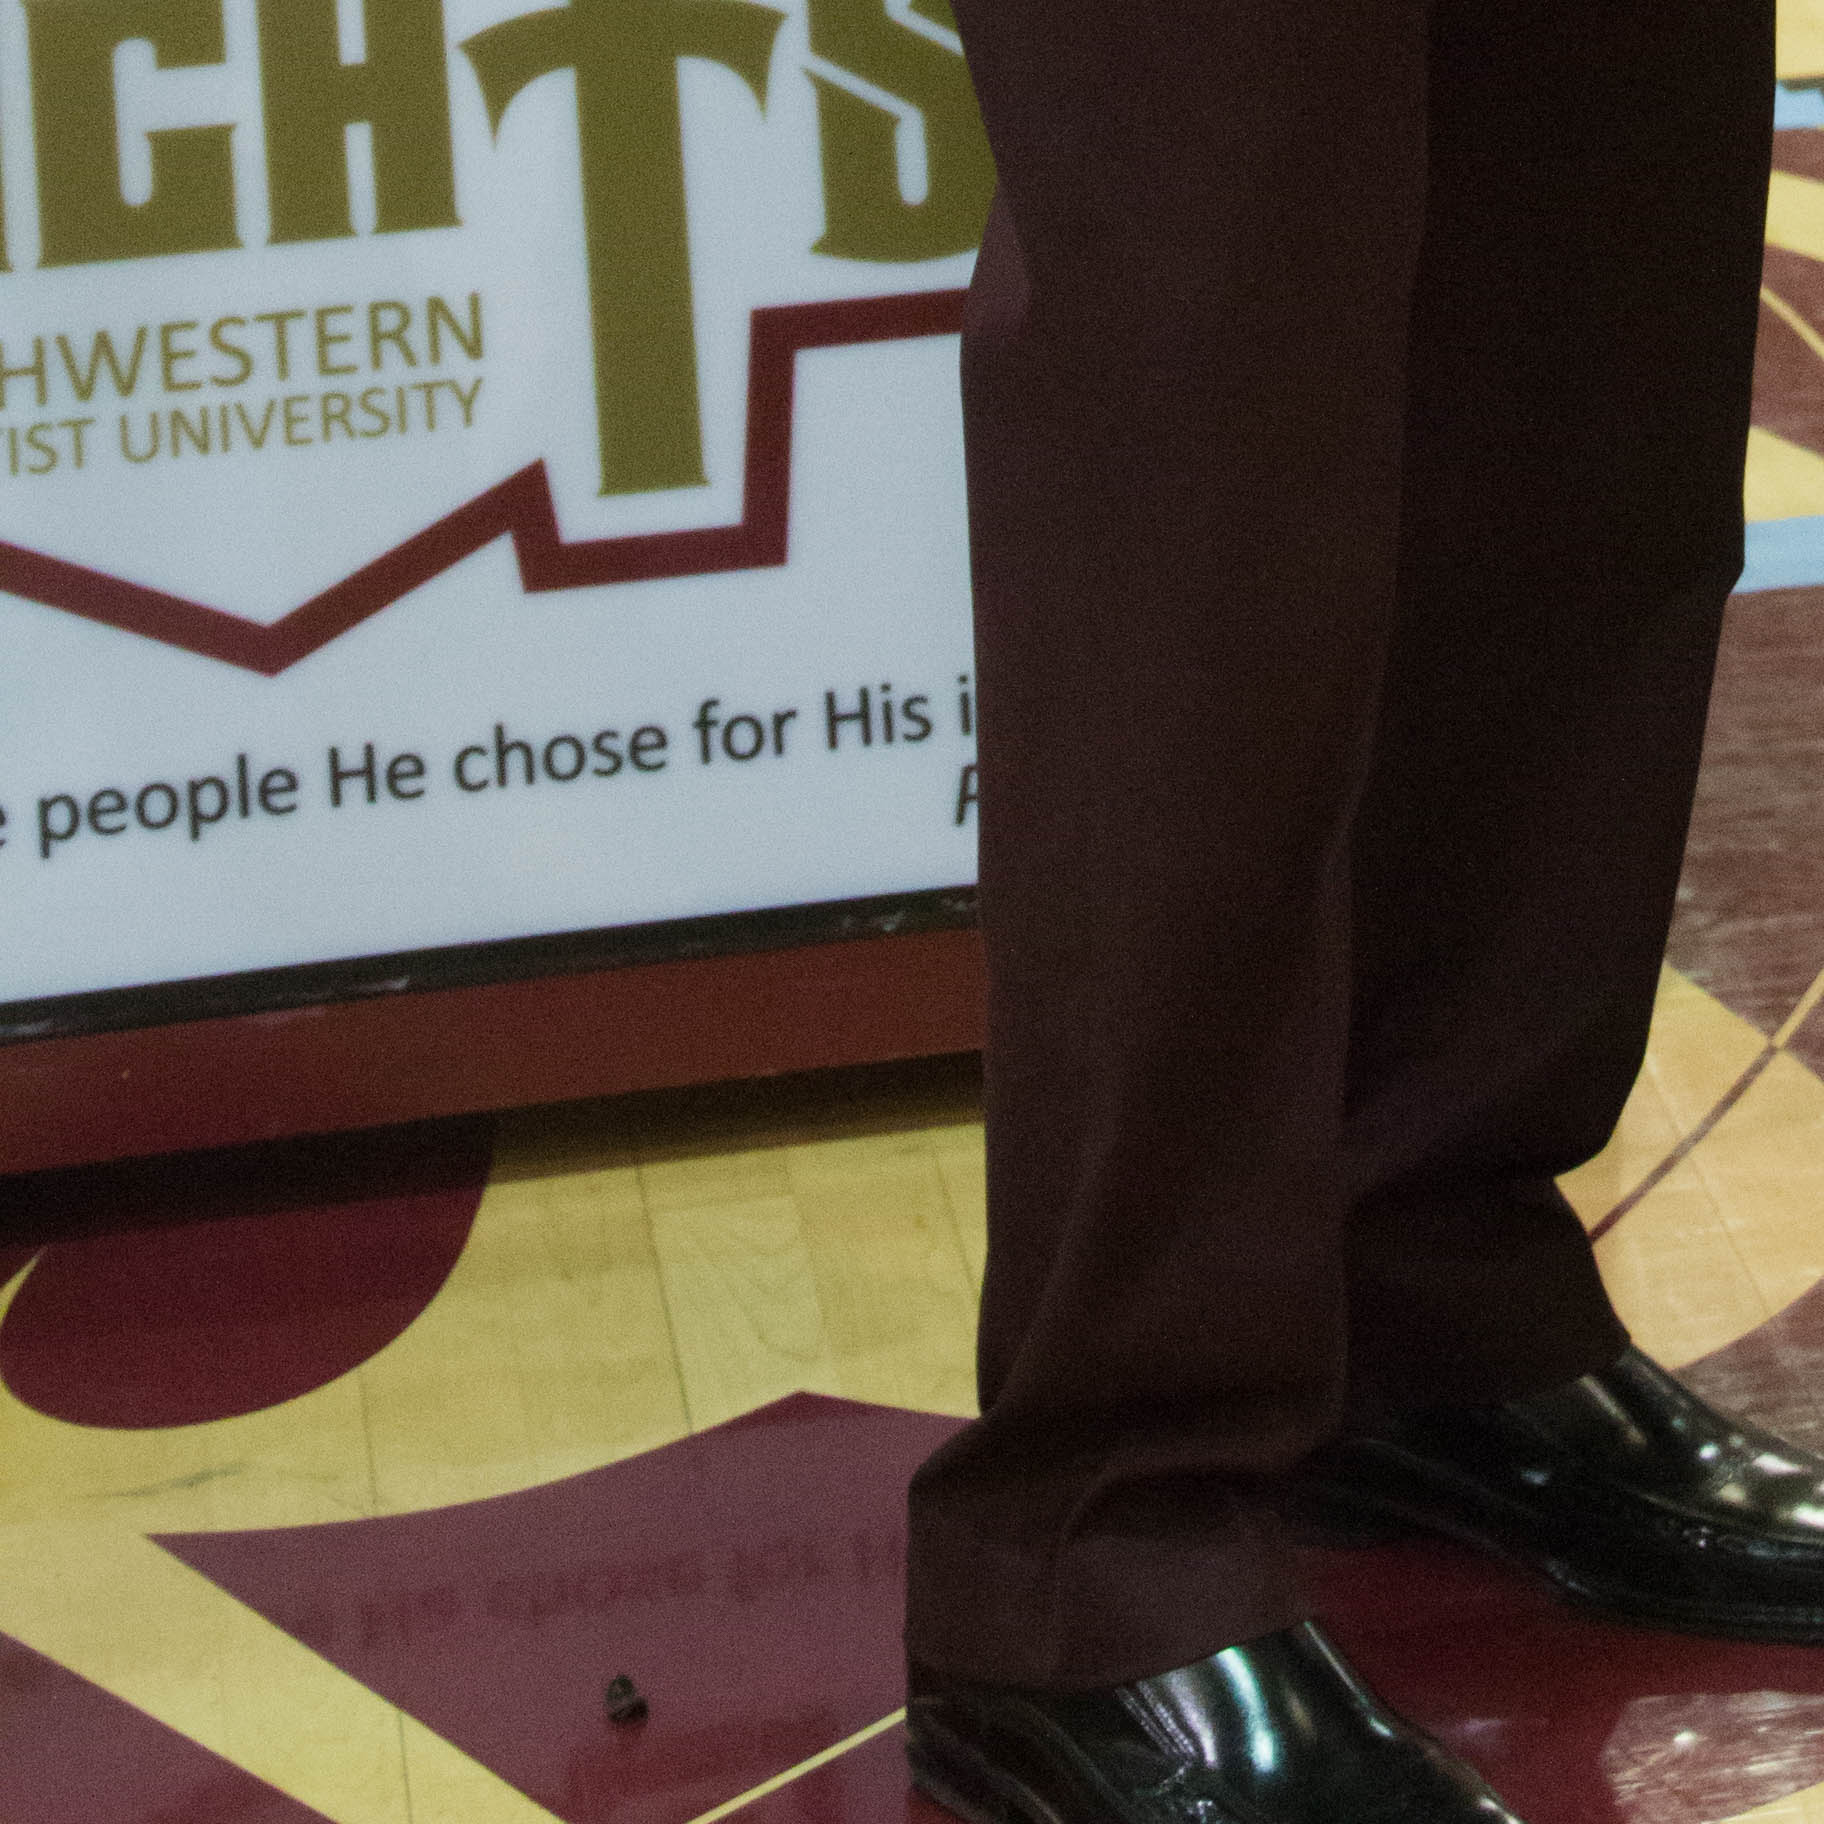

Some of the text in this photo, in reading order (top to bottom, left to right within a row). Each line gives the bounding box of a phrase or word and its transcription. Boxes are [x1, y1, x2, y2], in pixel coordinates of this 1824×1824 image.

[0, 377, 484, 477] IST UNIVERSITY
[37, 752, 299, 859] people
[328, 741, 427, 808] He
[453, 721, 668, 793] chose
[692, 697, 797, 765] for
[825, 682, 933, 751] His
